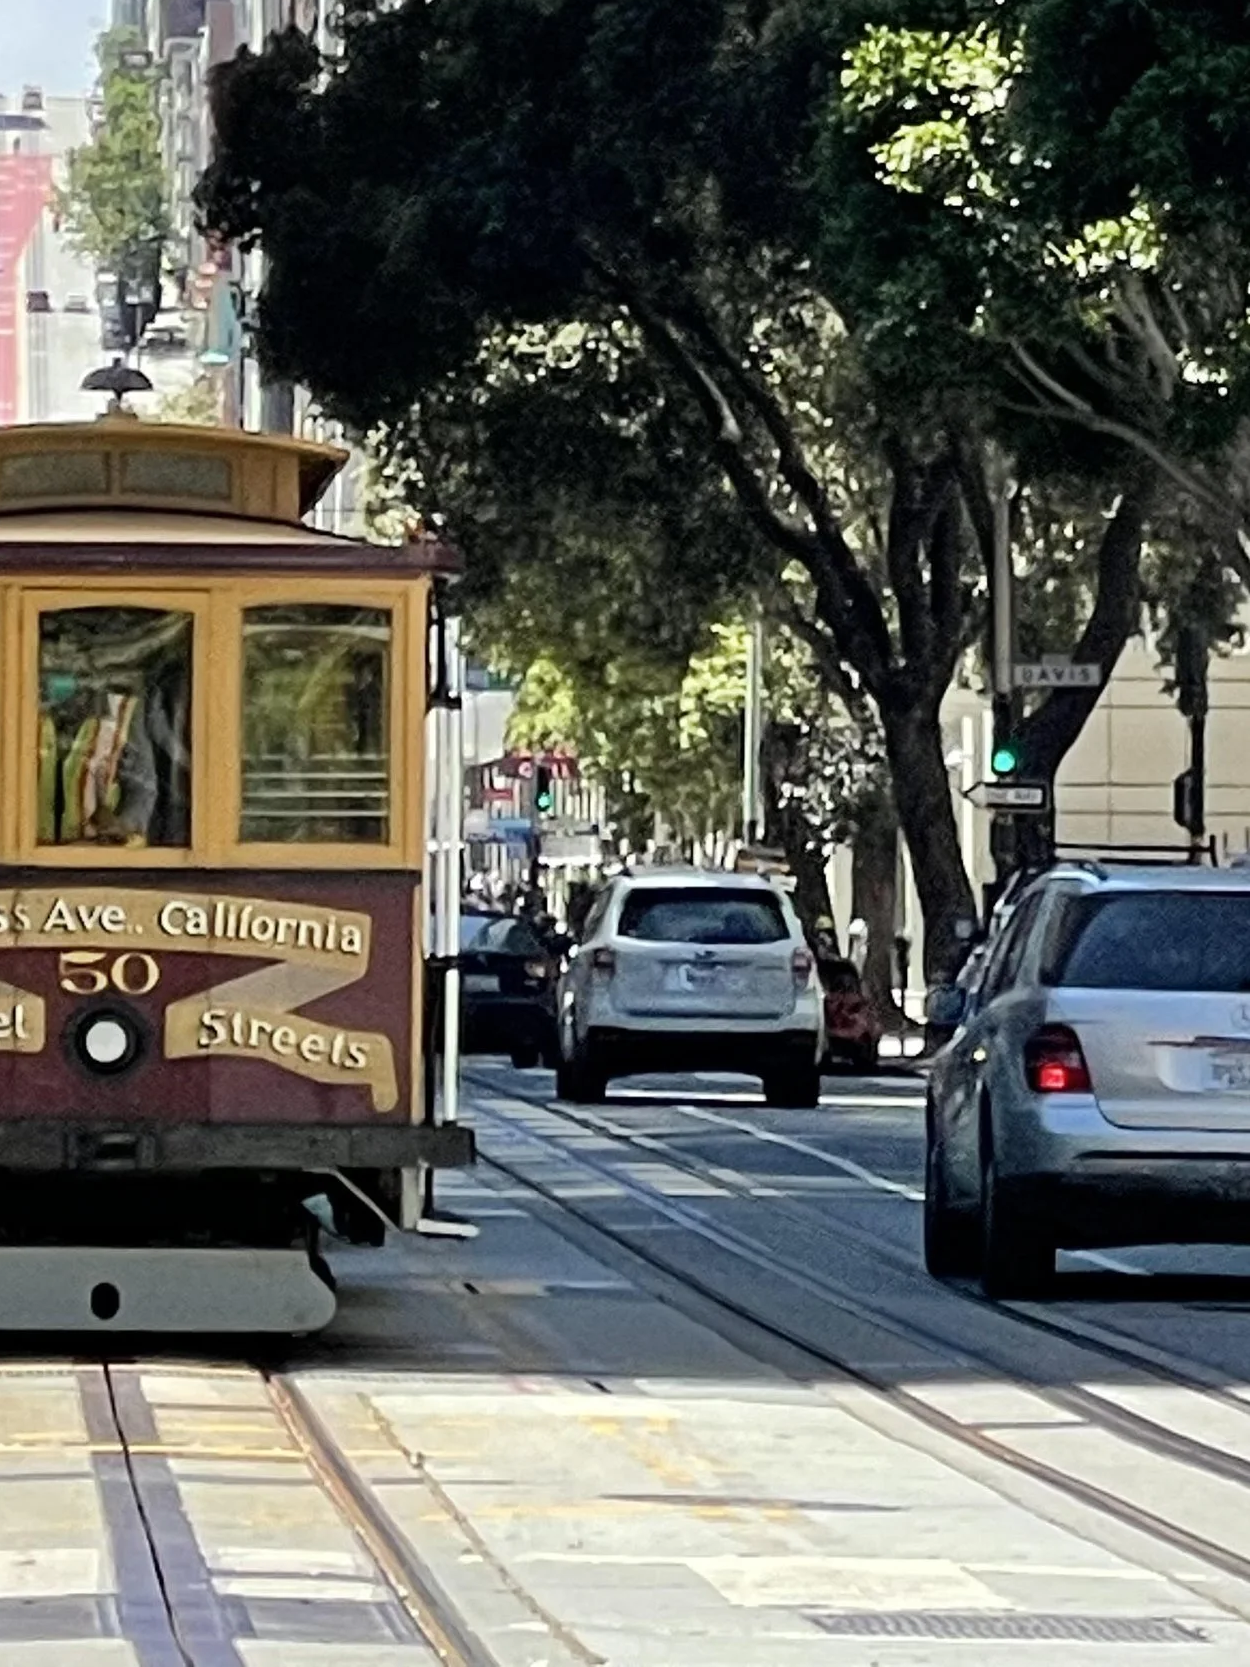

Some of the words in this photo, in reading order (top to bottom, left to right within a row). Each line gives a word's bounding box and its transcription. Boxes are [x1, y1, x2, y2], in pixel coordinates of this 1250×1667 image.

[1021, 667, 1091, 682] DAVIS
[159, 900, 362, 954] California
[59, 950, 161, 995] 50
[197, 1008, 371, 1070] Streets
